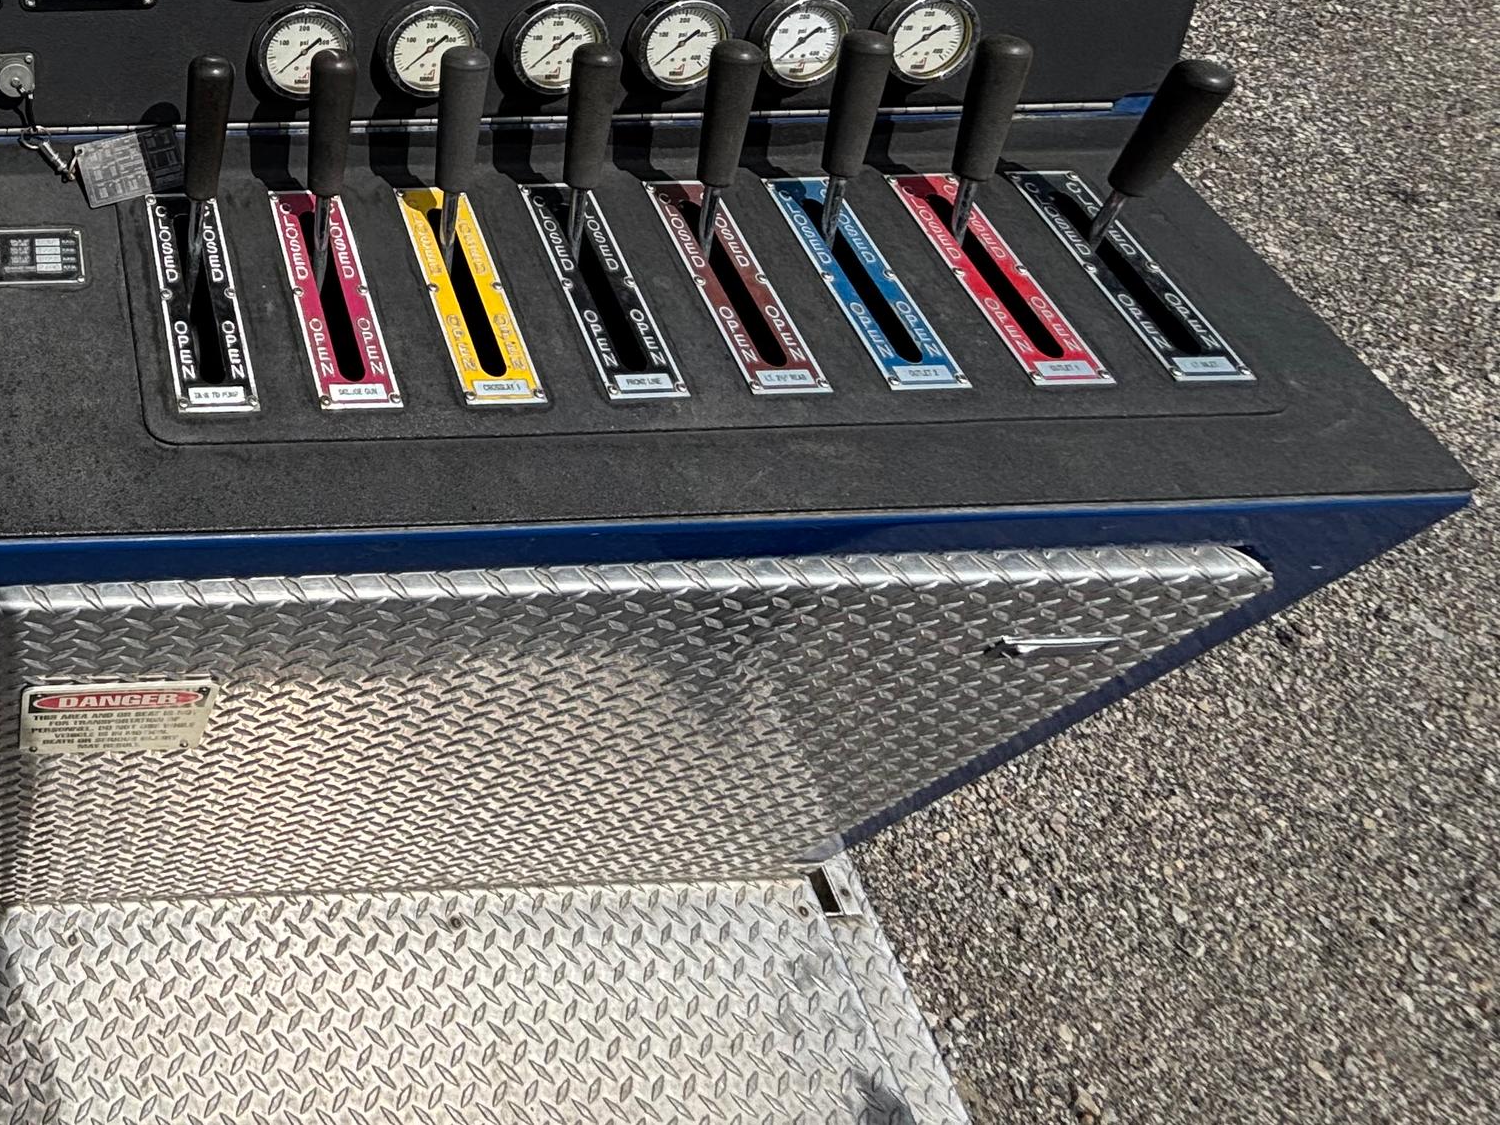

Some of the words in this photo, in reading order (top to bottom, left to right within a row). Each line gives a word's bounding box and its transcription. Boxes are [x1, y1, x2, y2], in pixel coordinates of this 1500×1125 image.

[299, 39, 309, 47] psi
[426, 36, 436, 45] psi
[552, 34, 562, 42] psi
[678, 31, 688, 39] psi
[155, 205, 179, 284] CLOSED
[279, 203, 309, 281] CLOSED
[532, 195, 575, 271] CLOSED
[658, 192, 706, 269] CLOSED
[778, 189, 832, 265] CLOSED
[901, 185, 962, 261] CLOSED
[1024, 181, 1093, 257] CLOSED
[309, 317, 335, 378] OPEN
[357, 317, 384, 376] OPEN
[446, 313, 479, 372] OPEN
[493, 313, 527, 371] OPEN
[583, 309, 620, 367] OPEN
[629, 308, 667, 366] OPEN
[718, 305, 760, 363] OPEN
[765, 304, 807, 362] OPEN
[849, 301, 894, 359] OPEN
[895, 300, 942, 357] OPEN
[983, 297, 1035, 354] OPEN
[1030, 295, 1083, 352] OPEN
[1116, 293, 1174, 351] OPEN
[1164, 291, 1222, 349] OPEN
[174, 320, 197, 380] OPEN
[221, 320, 246, 380] OPEN
[483, 382, 515, 391] CROSSLAY
[58, 693, 178, 708] DANGER
